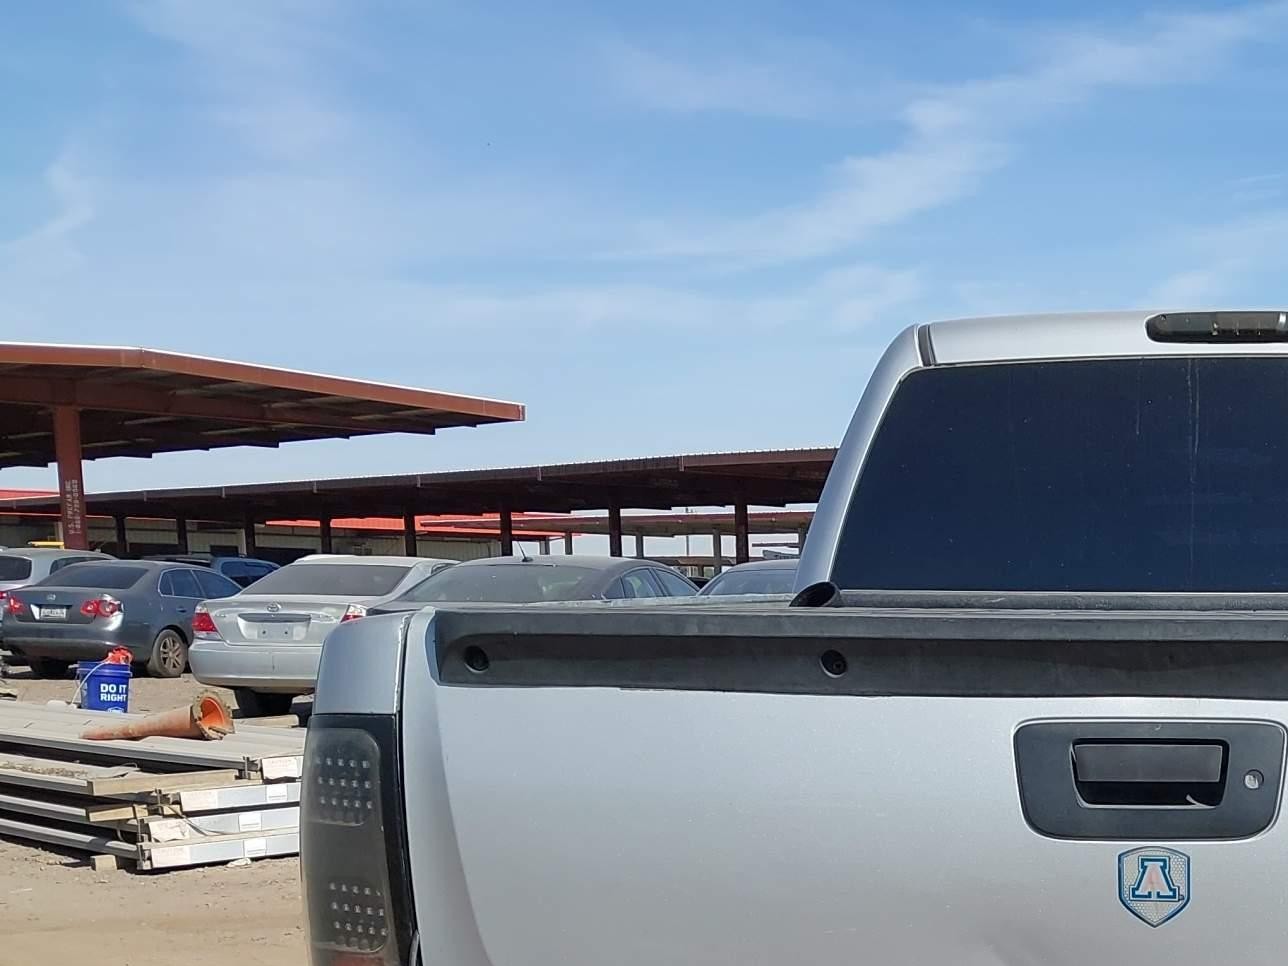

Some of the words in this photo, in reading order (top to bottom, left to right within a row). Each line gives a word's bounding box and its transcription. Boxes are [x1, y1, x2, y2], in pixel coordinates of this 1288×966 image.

[101, 684, 117, 693] DO
[119, 685, 127, 693] IT
[100, 694, 127, 702] RIGHT
